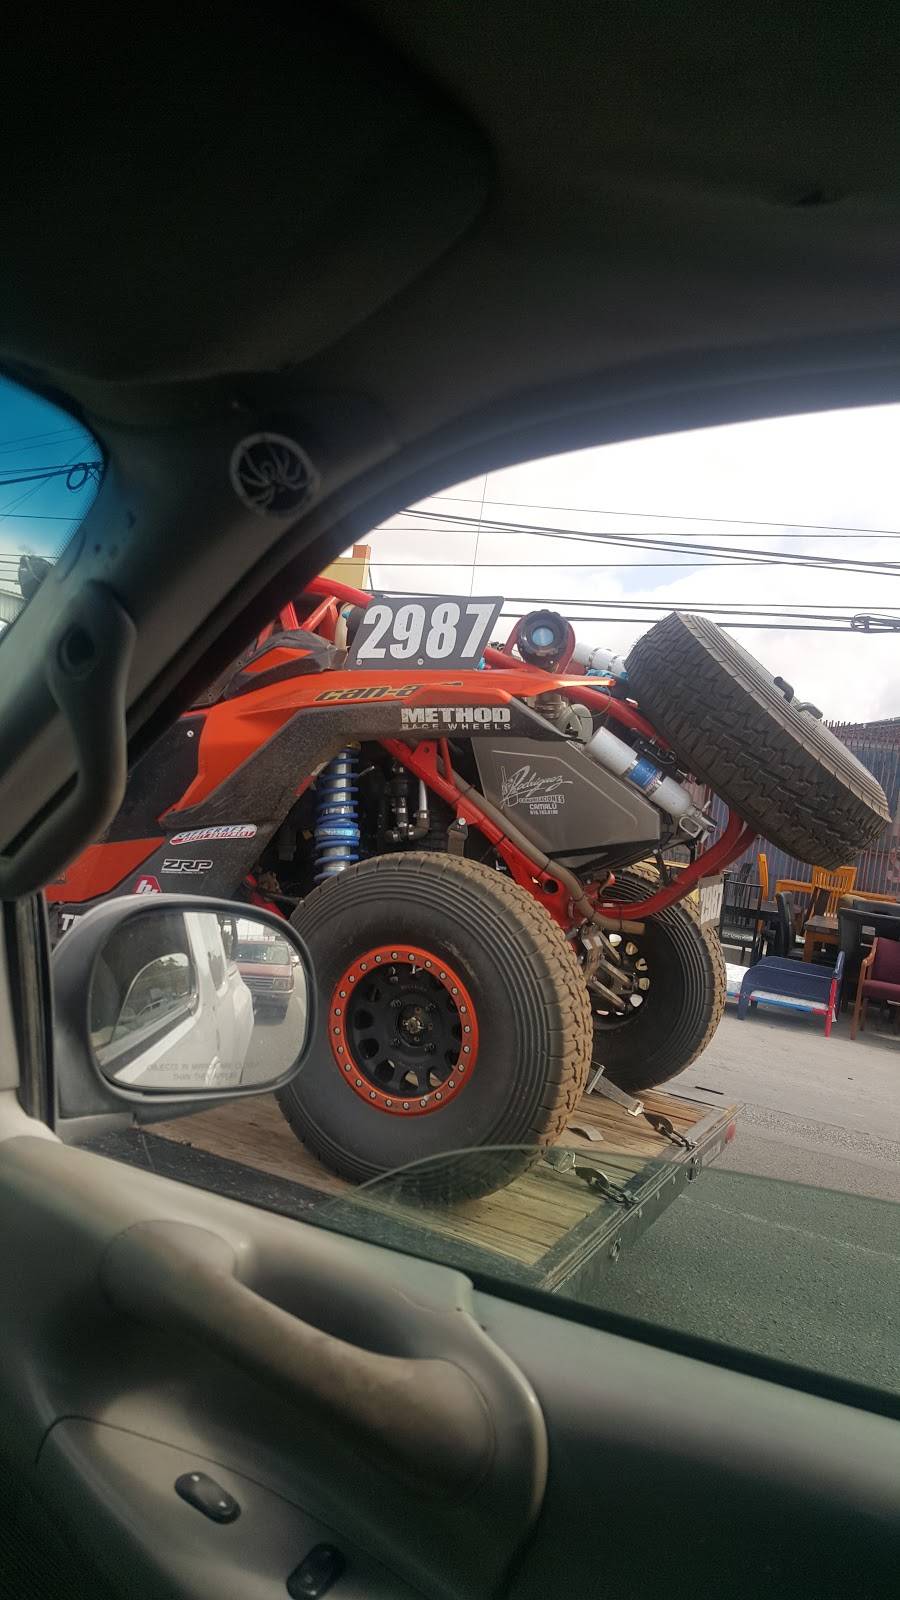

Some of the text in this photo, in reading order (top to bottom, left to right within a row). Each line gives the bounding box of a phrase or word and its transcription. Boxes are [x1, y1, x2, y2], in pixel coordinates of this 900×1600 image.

[357, 603, 496, 659] 2987
[315, 682, 463, 701] can-a
[401, 707, 511, 723] METHOD
[162, 859, 213, 872] ZRP
